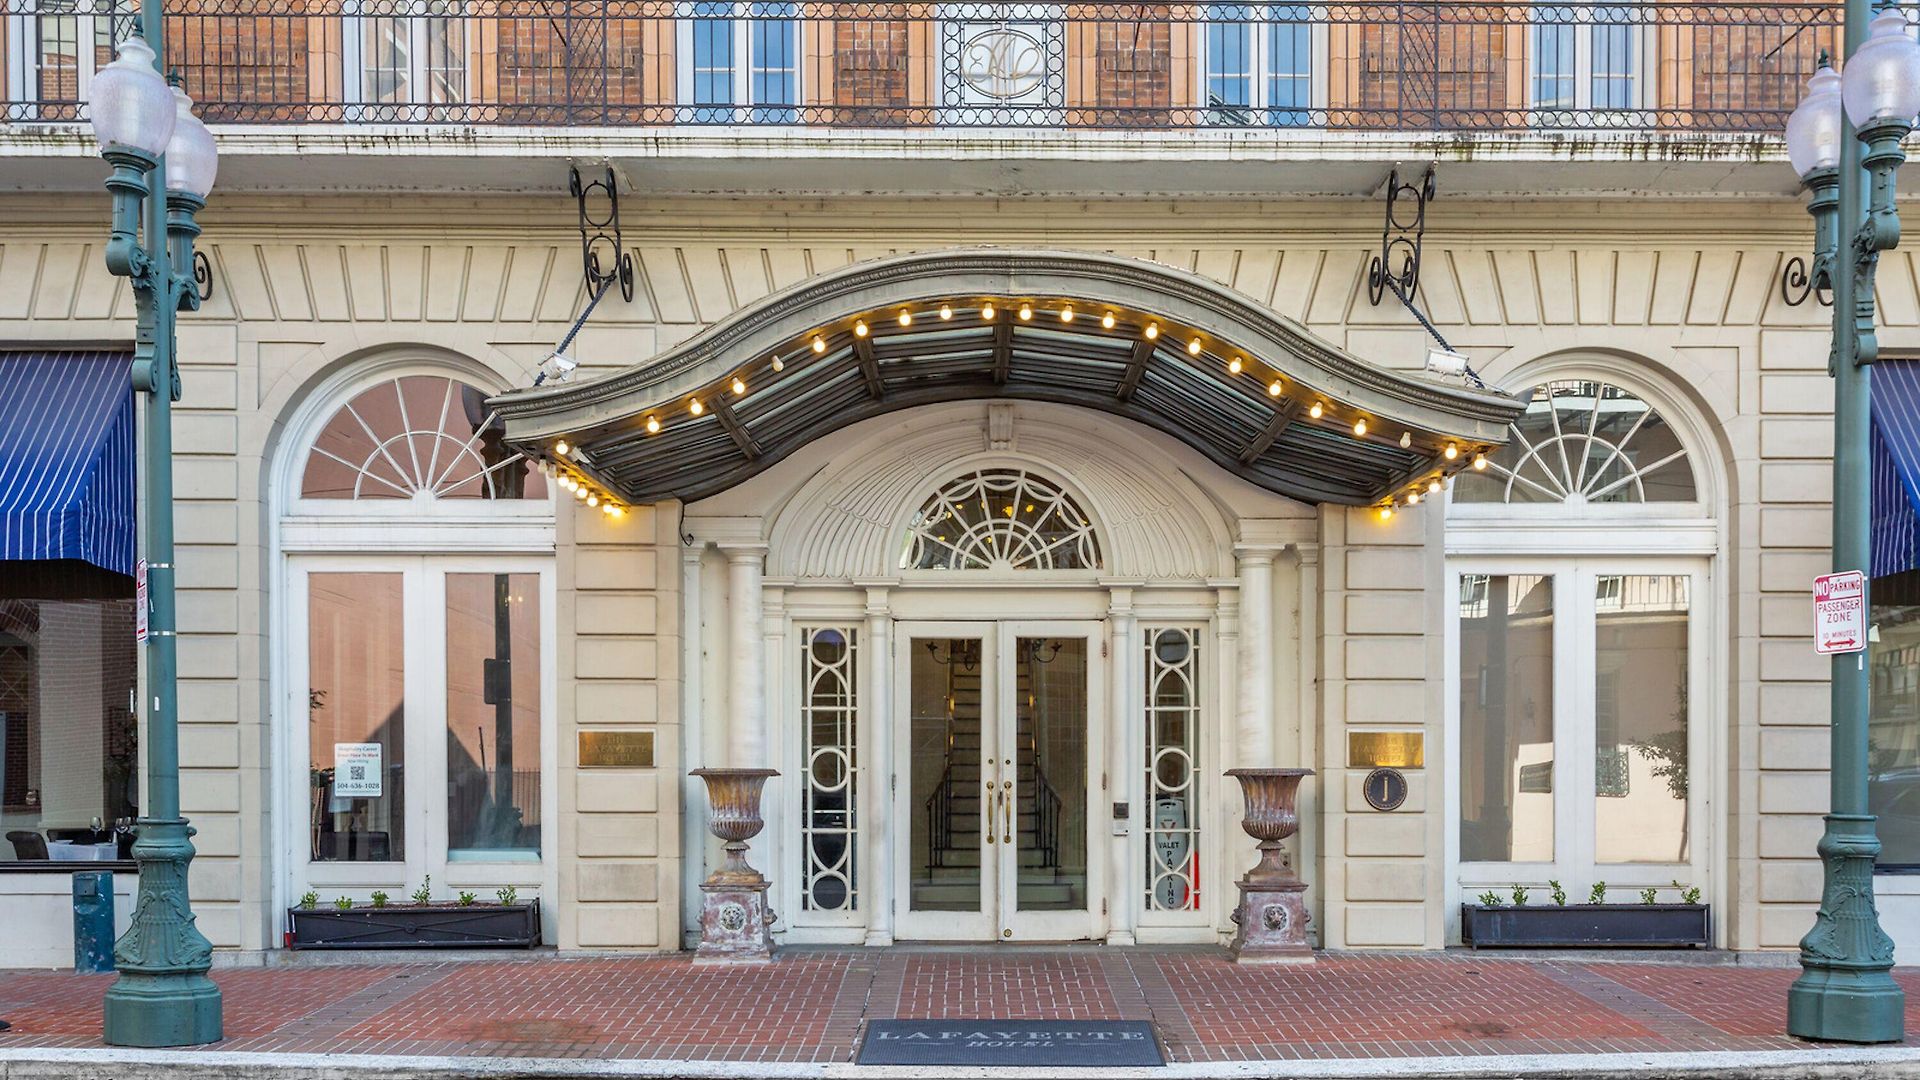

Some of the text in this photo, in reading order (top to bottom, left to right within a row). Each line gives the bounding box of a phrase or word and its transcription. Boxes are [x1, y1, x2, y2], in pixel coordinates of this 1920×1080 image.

[1816, 580, 1861, 596] NO PARKING
[1818, 600, 1860, 613] PASSENGER
[1827, 612, 1852, 623] ZONE
[877, 1031, 1145, 1040] LAFAYETTE
